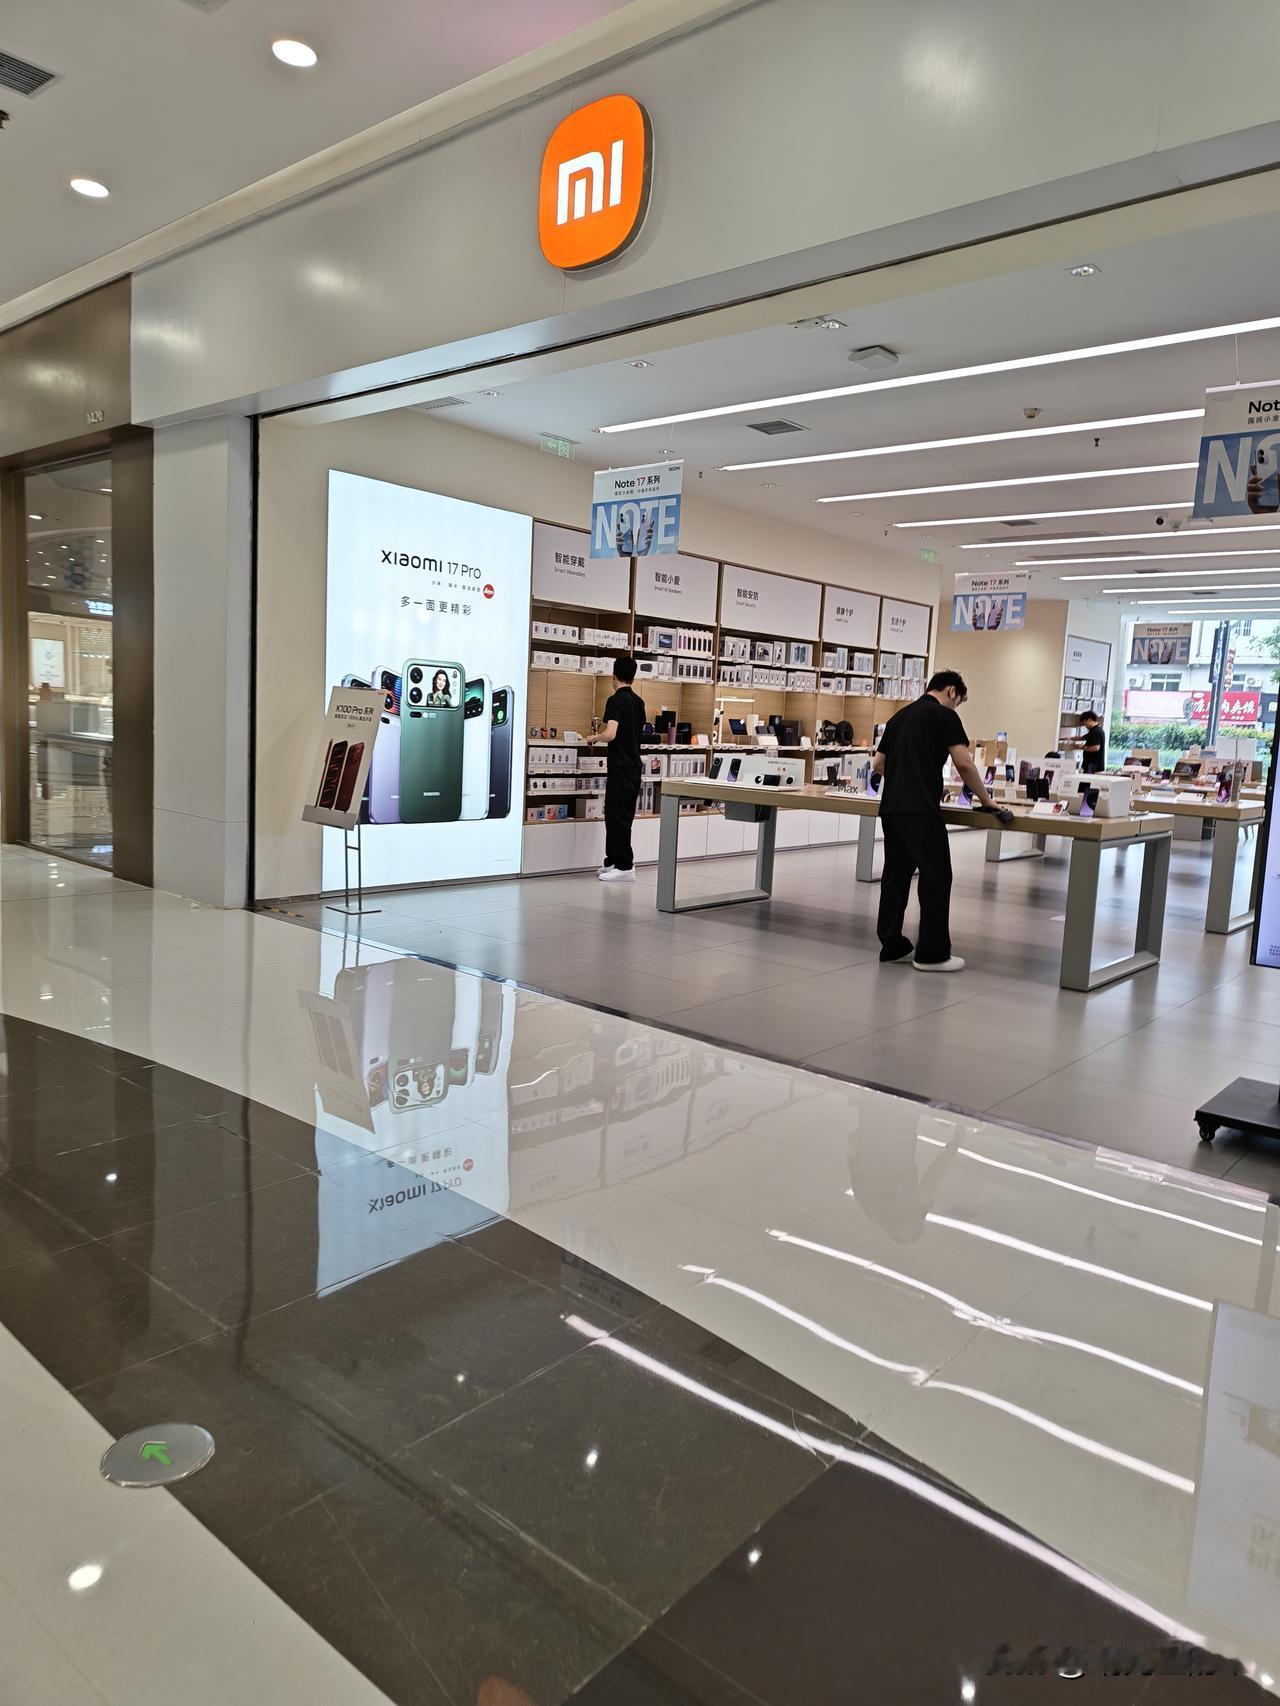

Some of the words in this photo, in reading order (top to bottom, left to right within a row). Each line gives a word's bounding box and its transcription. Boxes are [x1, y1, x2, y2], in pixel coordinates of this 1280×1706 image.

[614, 480, 635, 489] Note
[637, 476, 646, 486] 17
[647, 475, 660, 485] 系列
[554, 552, 585, 568] 智能穿戴
[447, 561, 459, 576] 17
[461, 564, 482, 579] Pro
[655, 572, 681, 586] 智能小爱
[971, 580, 988, 588] Note
[400, 596, 472, 616] 多一面更精彩
[352, 705, 363, 715] Pro
